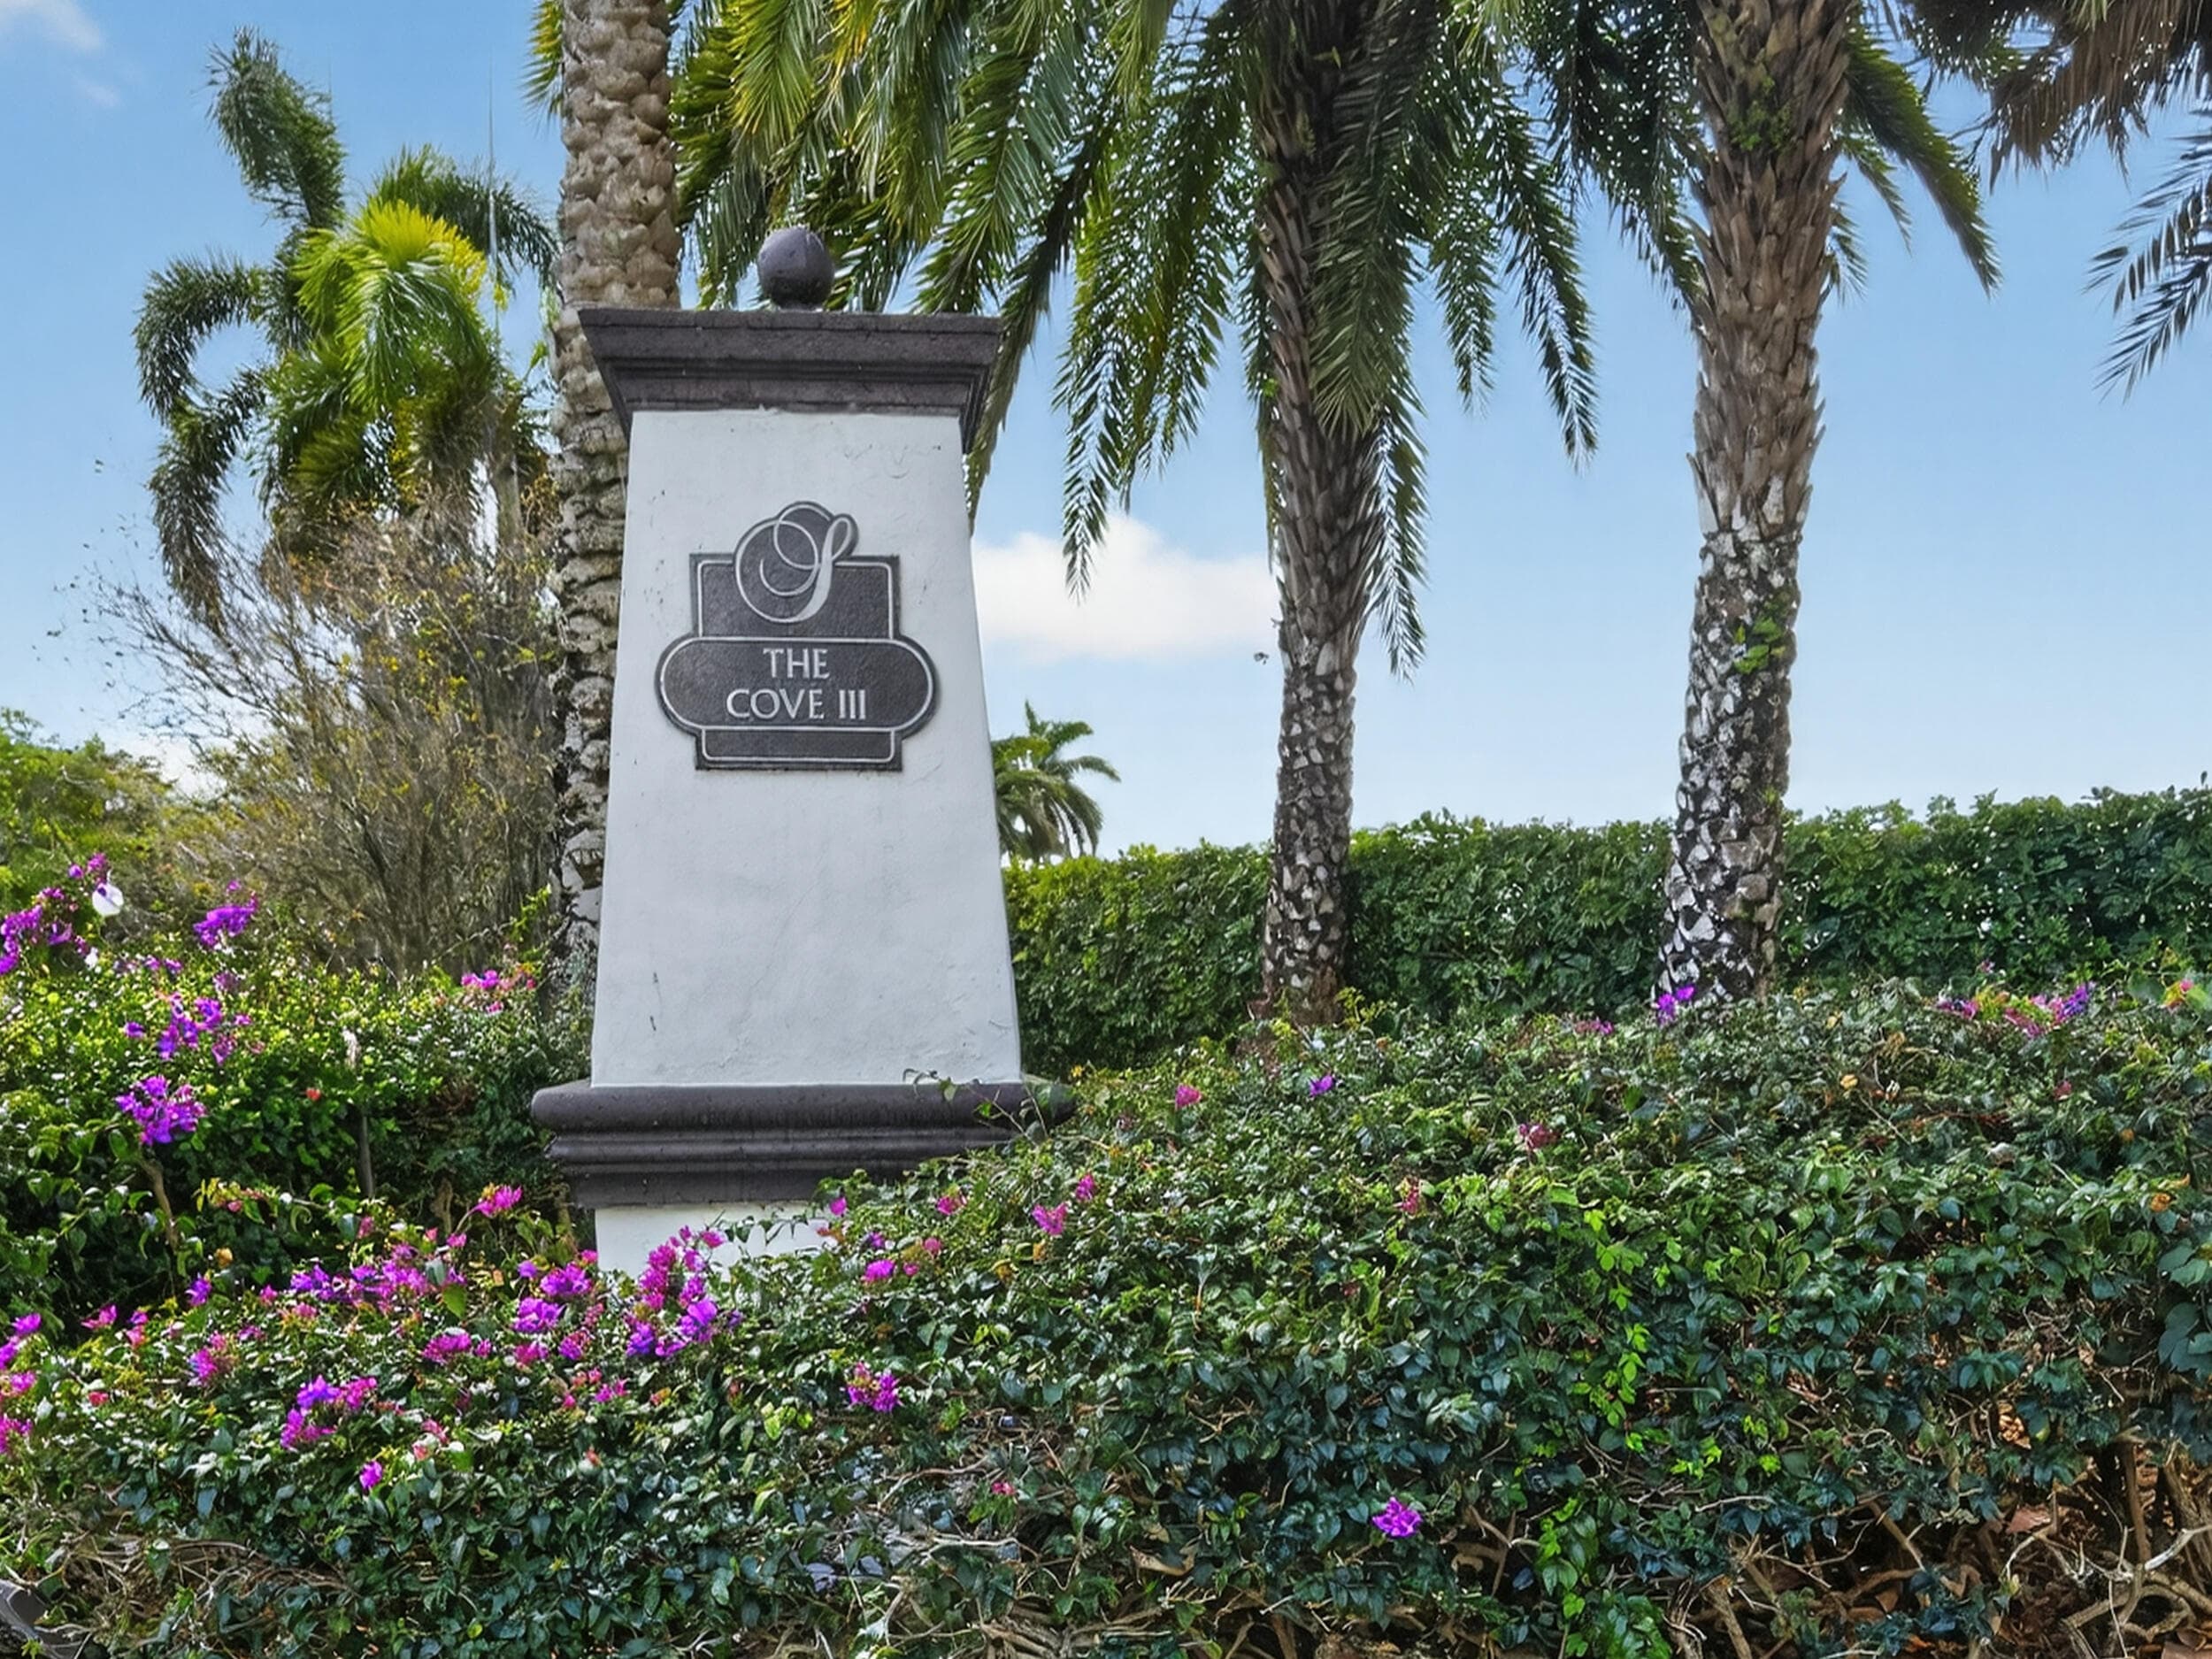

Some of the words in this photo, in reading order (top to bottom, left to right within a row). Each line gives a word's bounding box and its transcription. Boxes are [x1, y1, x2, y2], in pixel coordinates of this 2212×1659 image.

[763, 648, 830, 679] THE
[726, 688, 825, 719] COVE
[838, 689, 866, 719] III
